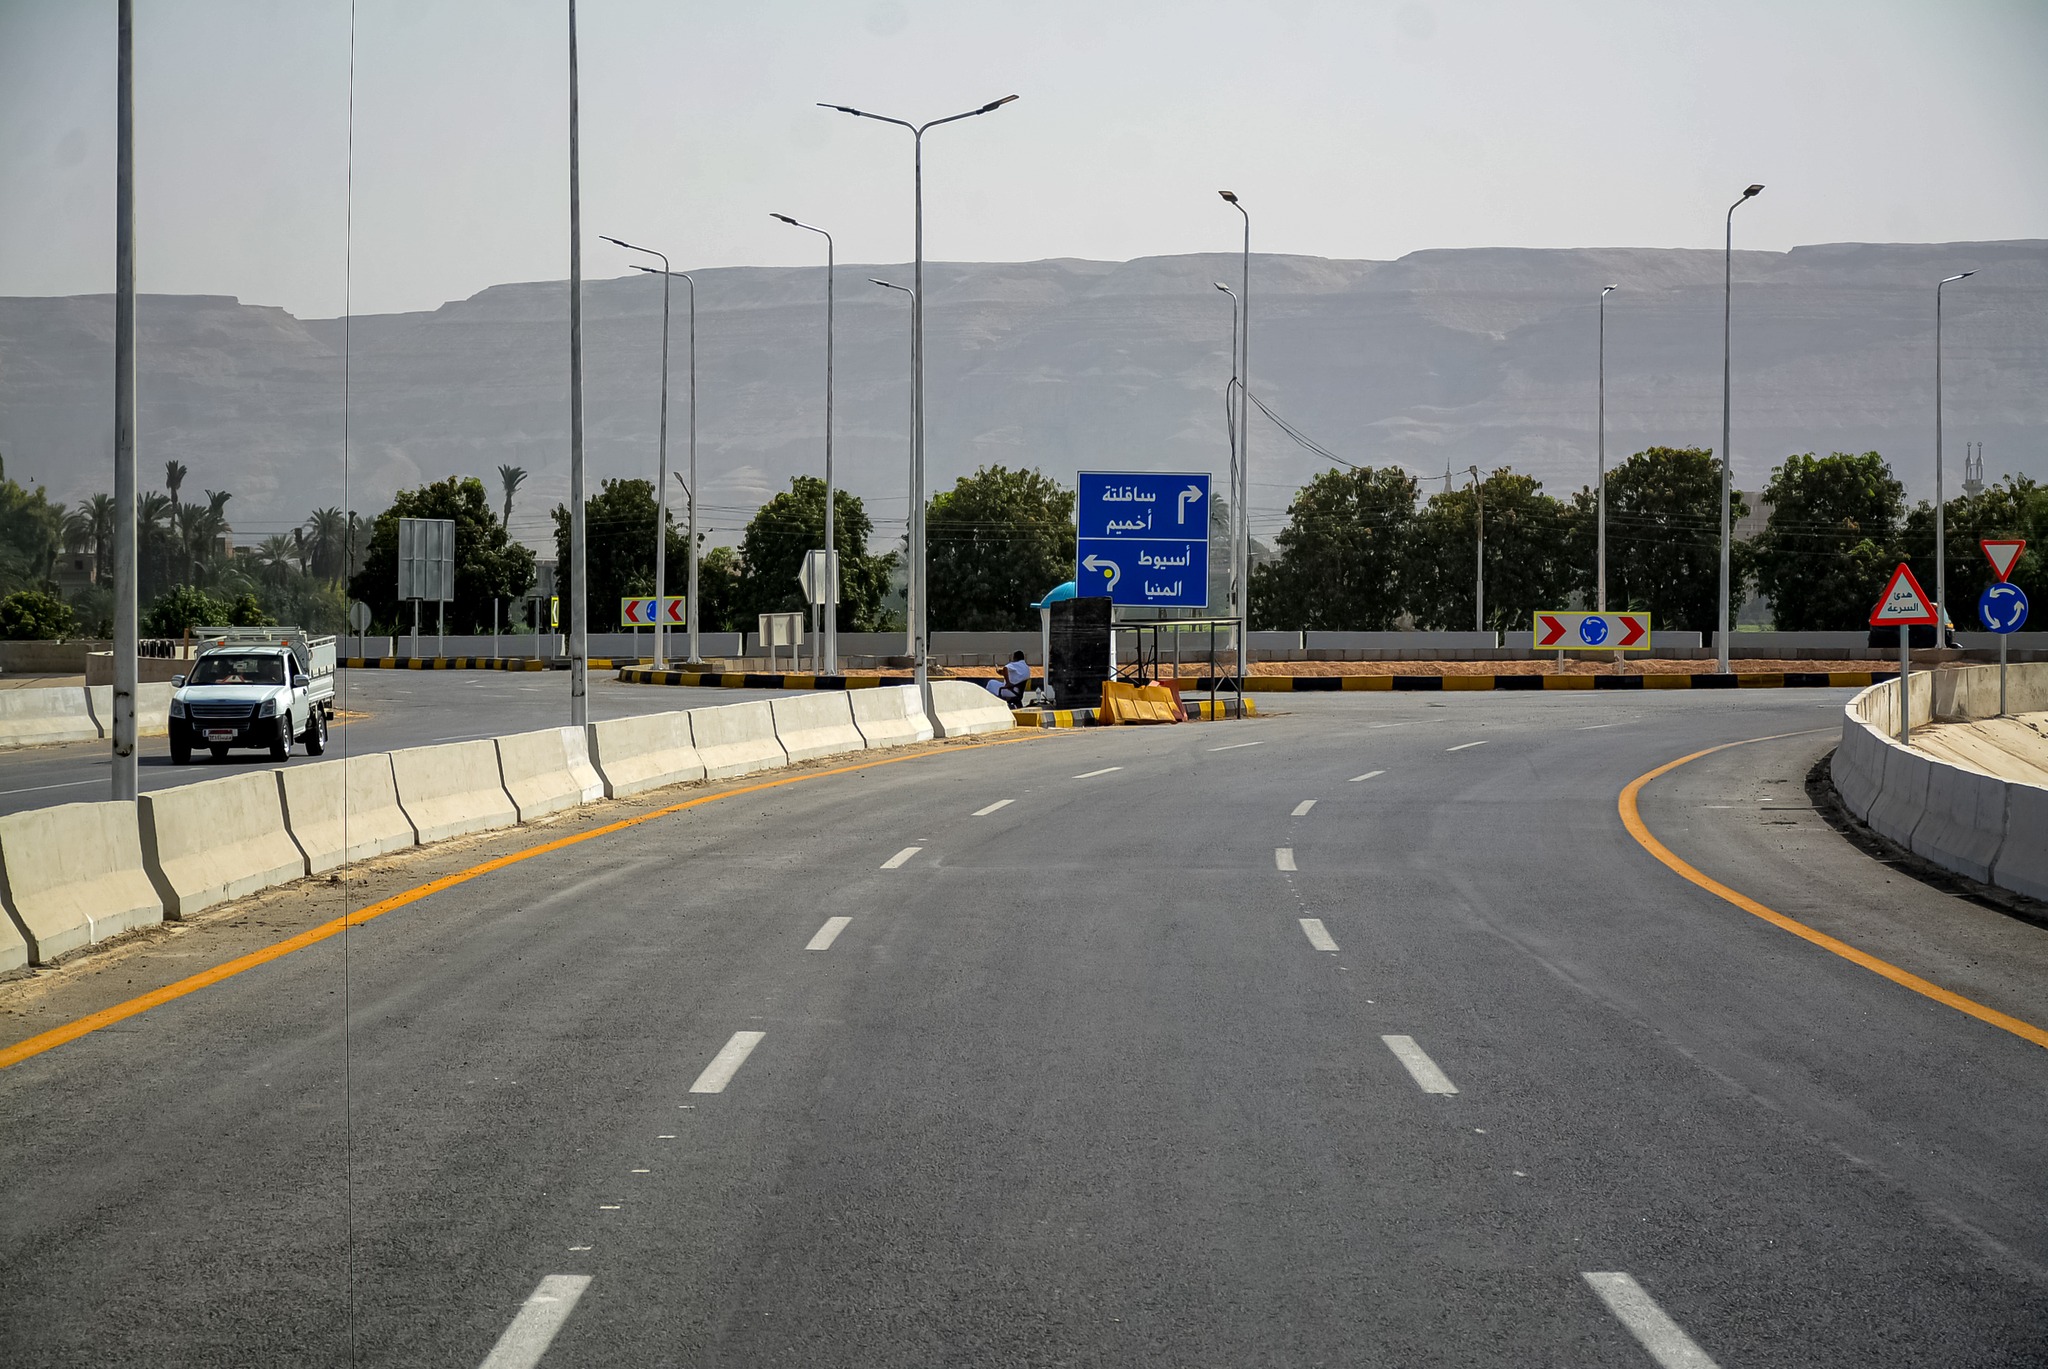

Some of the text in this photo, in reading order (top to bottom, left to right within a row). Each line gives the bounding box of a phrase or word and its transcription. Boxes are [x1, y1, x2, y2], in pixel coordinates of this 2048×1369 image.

[1102, 485, 1156, 502] ساقلتة
[1106, 508, 1152, 535] أخميم
[1138, 545, 1190, 570] أسيوط
[1144, 580, 1182, 600] المنيا
[1887, 602, 1919, 614] السرعة
